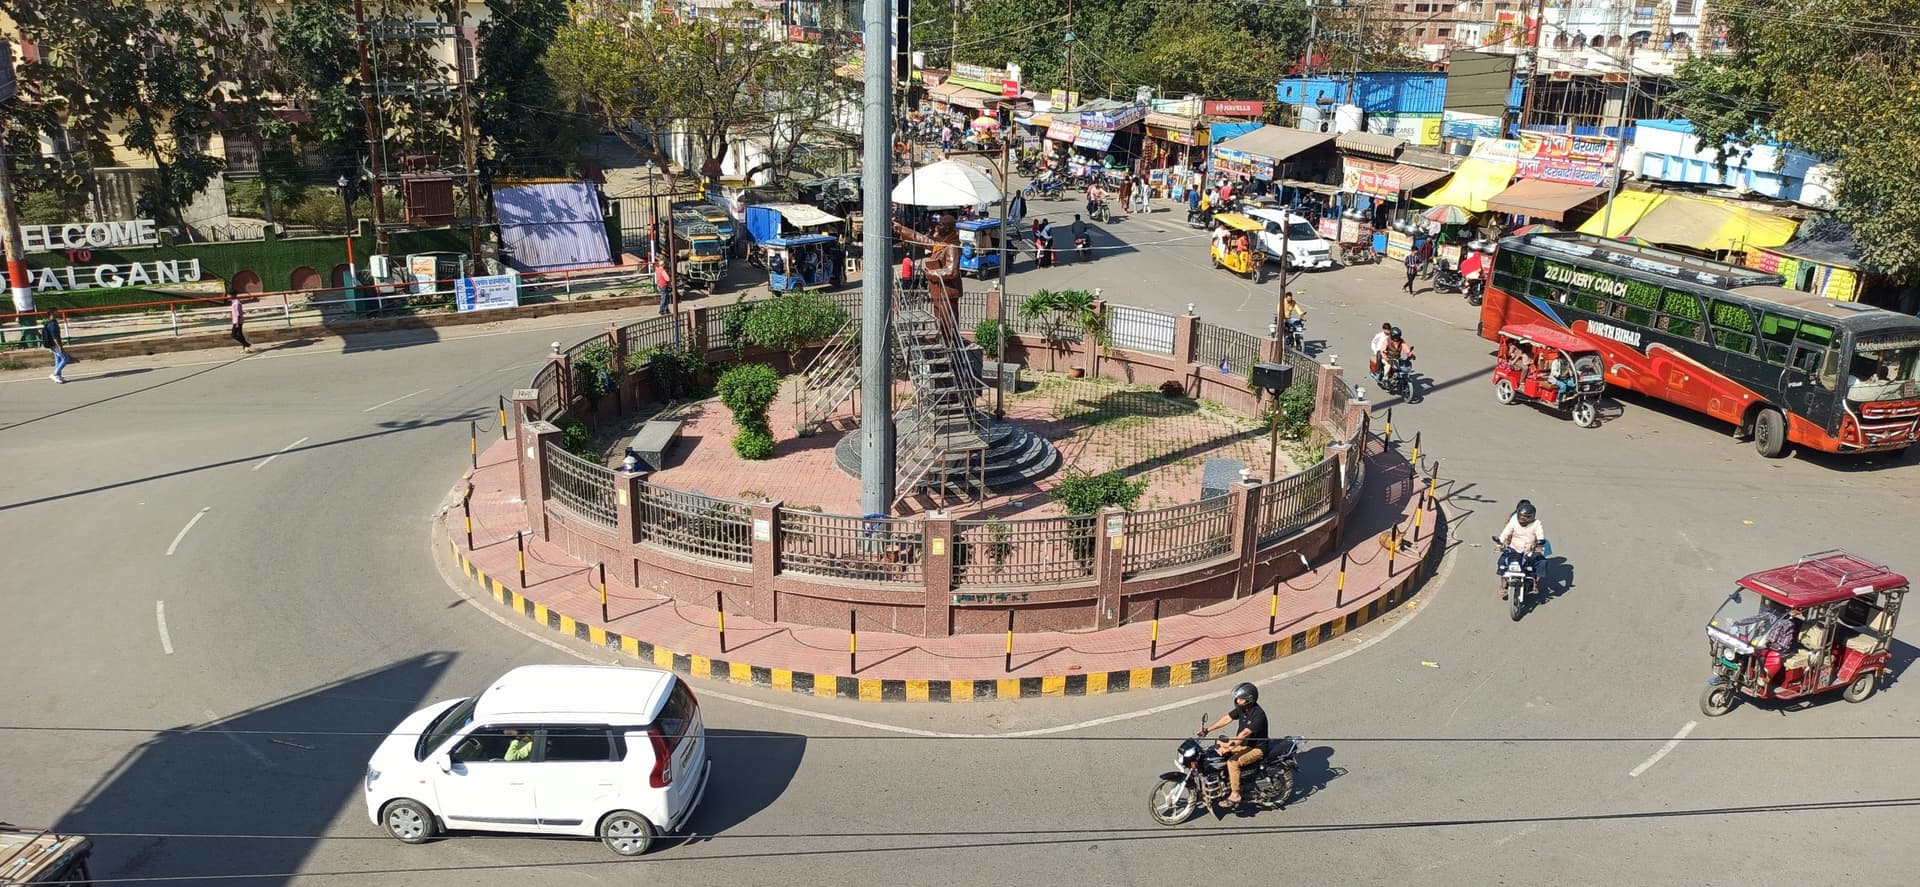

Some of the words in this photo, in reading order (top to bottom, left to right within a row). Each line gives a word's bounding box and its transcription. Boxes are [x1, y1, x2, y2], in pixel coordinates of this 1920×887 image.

[1543, 134, 1569, 155] गुप्ता
[0, 219, 158, 251] ELCOME
[66, 248, 92, 263] TO
[1544, 265, 1559, 281] 2/2
[1558, 268, 1596, 289] LUXERY
[1594, 278, 1628, 298] COACH
[1586, 319, 1615, 340] NORTH
[1614, 329, 1641, 347] BIHAR
